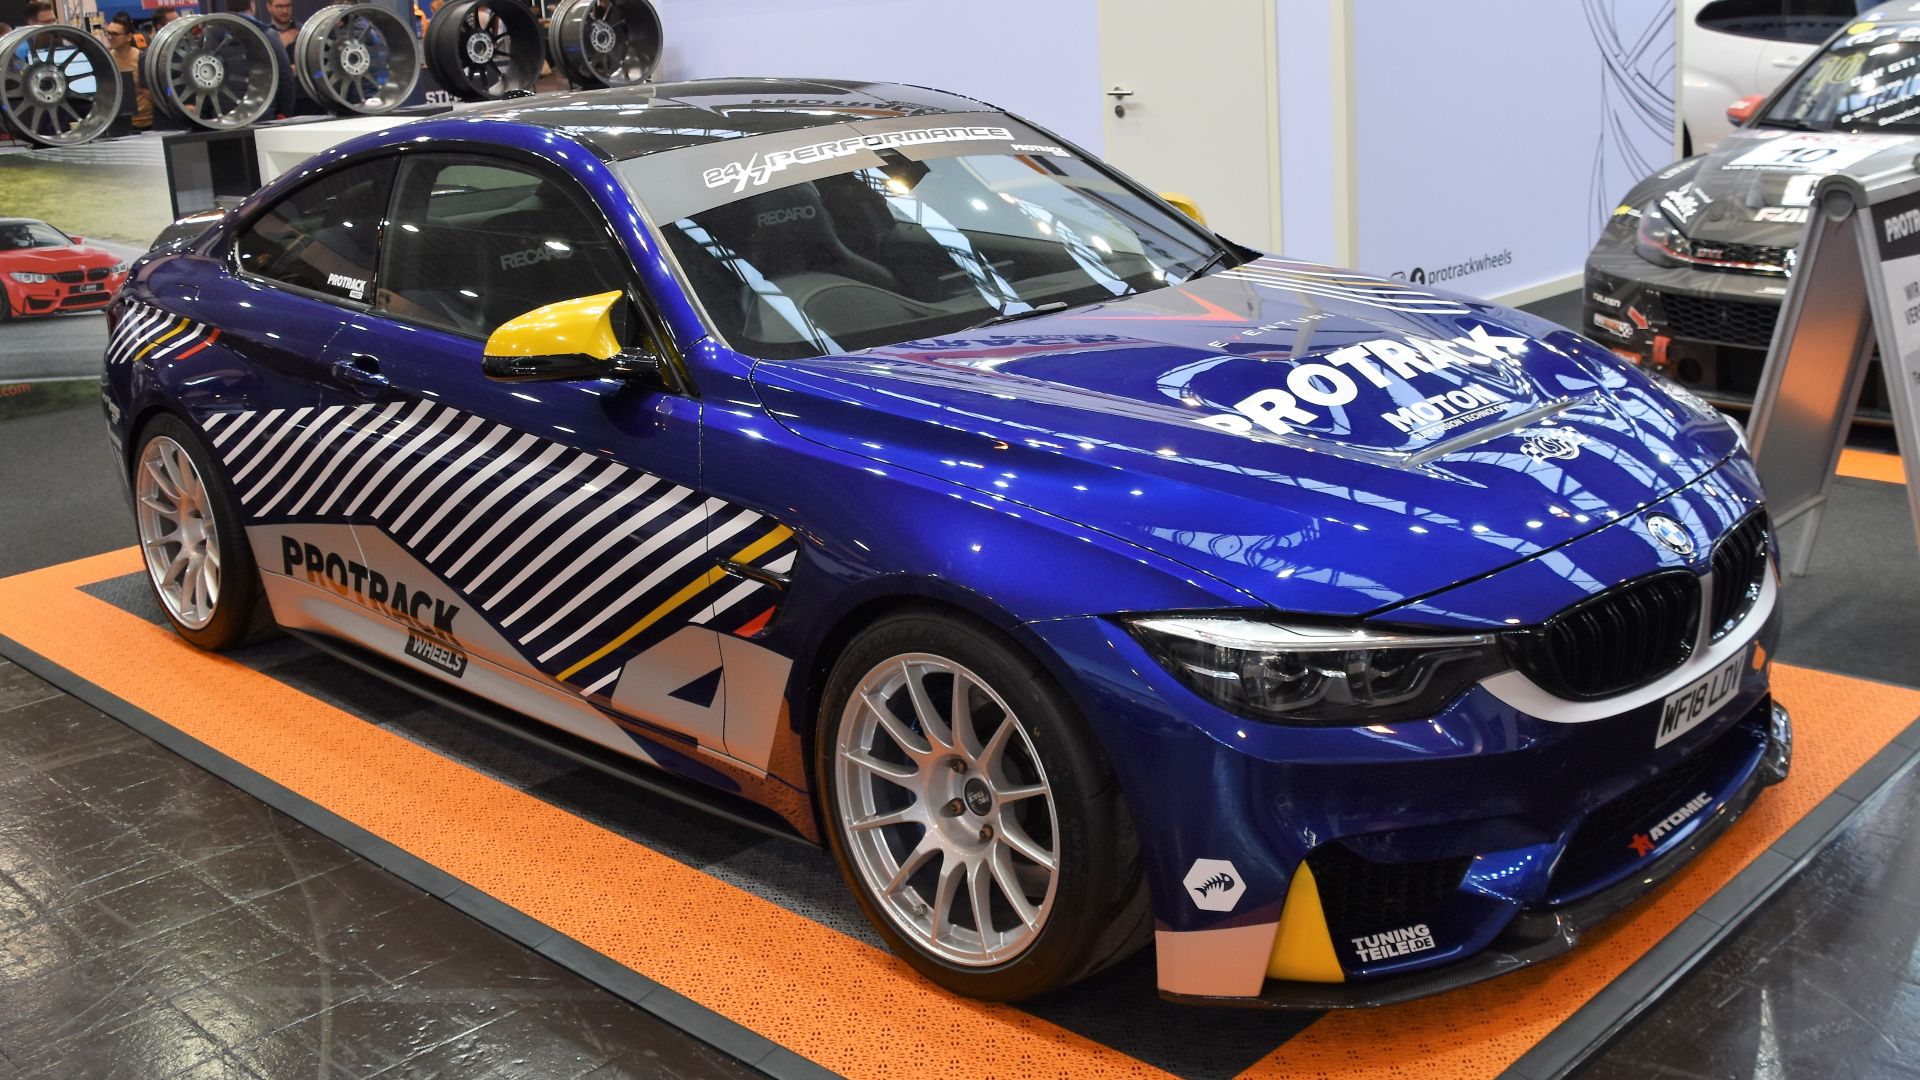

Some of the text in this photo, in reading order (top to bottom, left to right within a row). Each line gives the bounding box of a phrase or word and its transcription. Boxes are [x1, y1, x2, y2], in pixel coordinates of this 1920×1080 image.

[703, 127, 1014, 193] 24/7 PERFORMANCE
[1775, 147, 1838, 163] 10
[757, 205, 817, 228] RECARO
[327, 273, 366, 292] PROTRACK
[1428, 249, 1512, 286] protrackwheels
[1195, 325, 1528, 435] PROTRACK
[1380, 383, 1511, 433] MOTON
[282, 535, 465, 650] PROTRACK
[412, 635, 463, 672] WHEELS
[1660, 655, 1744, 737] WF18 LDV
[1649, 791, 1713, 841] ATOMIC
[1351, 924, 1430, 950] TUNING
